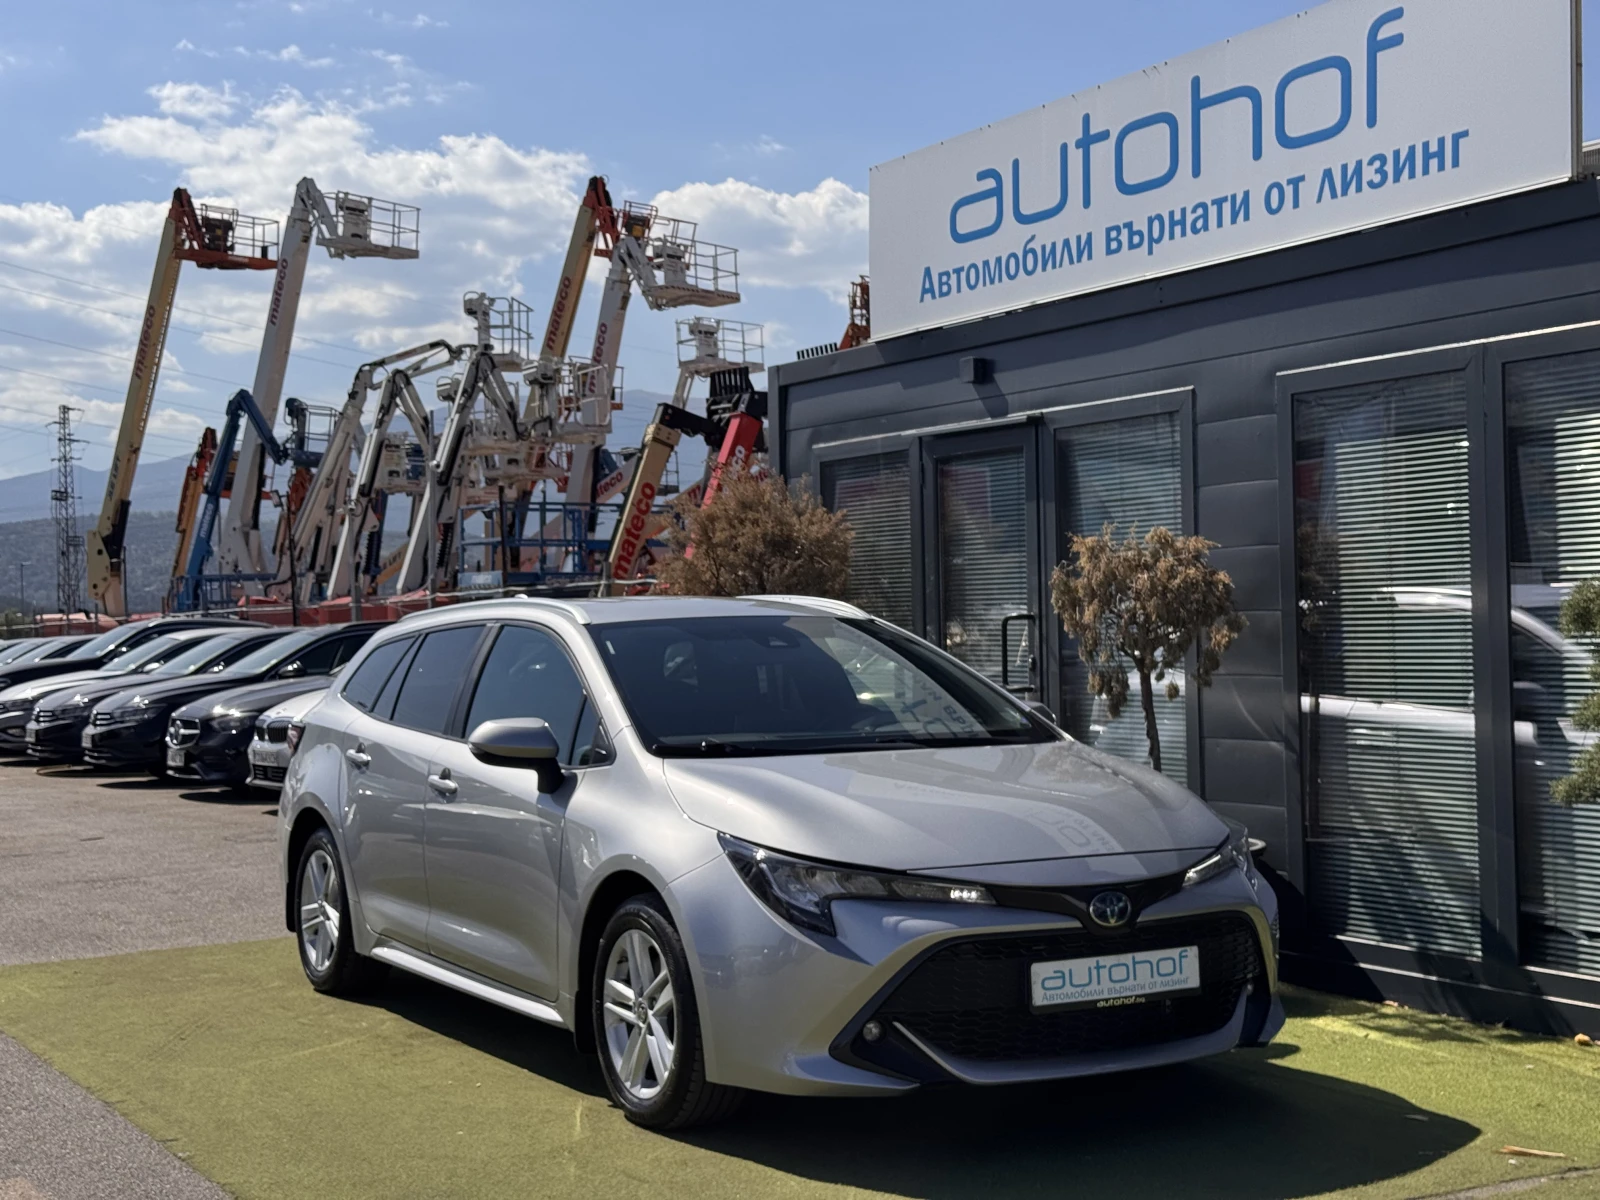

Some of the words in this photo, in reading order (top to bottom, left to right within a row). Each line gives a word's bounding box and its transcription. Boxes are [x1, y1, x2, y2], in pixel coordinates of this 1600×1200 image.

[949, 6, 1405, 244] autohof
[919, 229, 1093, 303] Автомобили
[1104, 187, 1251, 256] върнати
[1264, 174, 1306, 216] от
[1315, 129, 1470, 205] лизинг
[270, 258, 289, 327] mateco
[546, 275, 571, 351] mateco
[135, 305, 155, 380] mateco
[588, 322, 608, 394] mteco
[596, 471, 624, 499] teco
[612, 481, 656, 581] mateco
[1040, 949, 1189, 991] autohof
[1041, 986, 1104, 1003] Автомобили
[1107, 982, 1145, 997] върнати
[1148, 980, 1157, 991] от
[1159, 976, 1190, 989] лизинг
